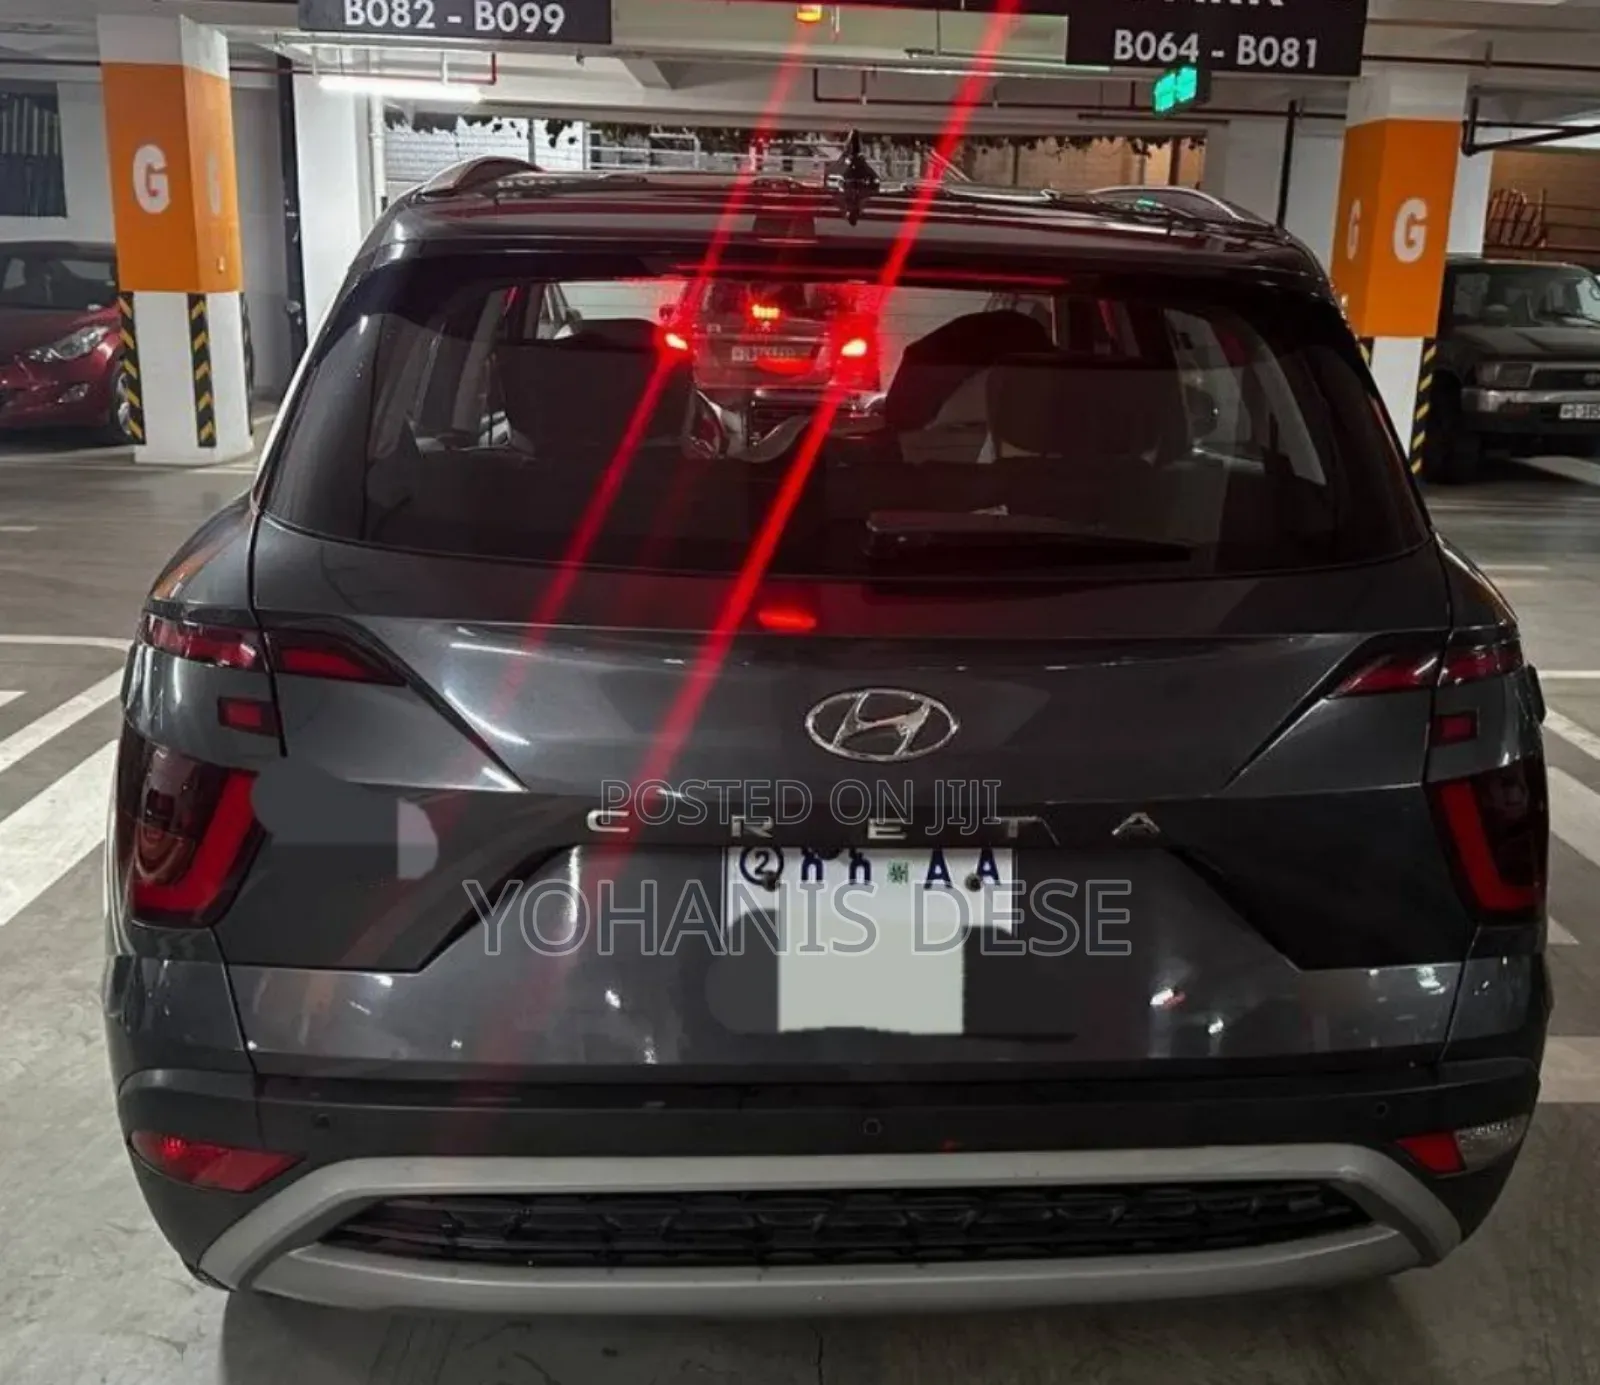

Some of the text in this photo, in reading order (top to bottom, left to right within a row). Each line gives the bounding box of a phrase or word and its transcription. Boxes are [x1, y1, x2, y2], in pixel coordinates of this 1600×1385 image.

[344, 0, 436, 29] B082
[474, 0, 566, 34] B099
[1113, 29, 1199, 63] B064
[1236, 35, 1318, 69] B081
[133, 143, 170, 215] G
[1393, 197, 1428, 264] G
[586, 806, 1161, 848] CRETA
